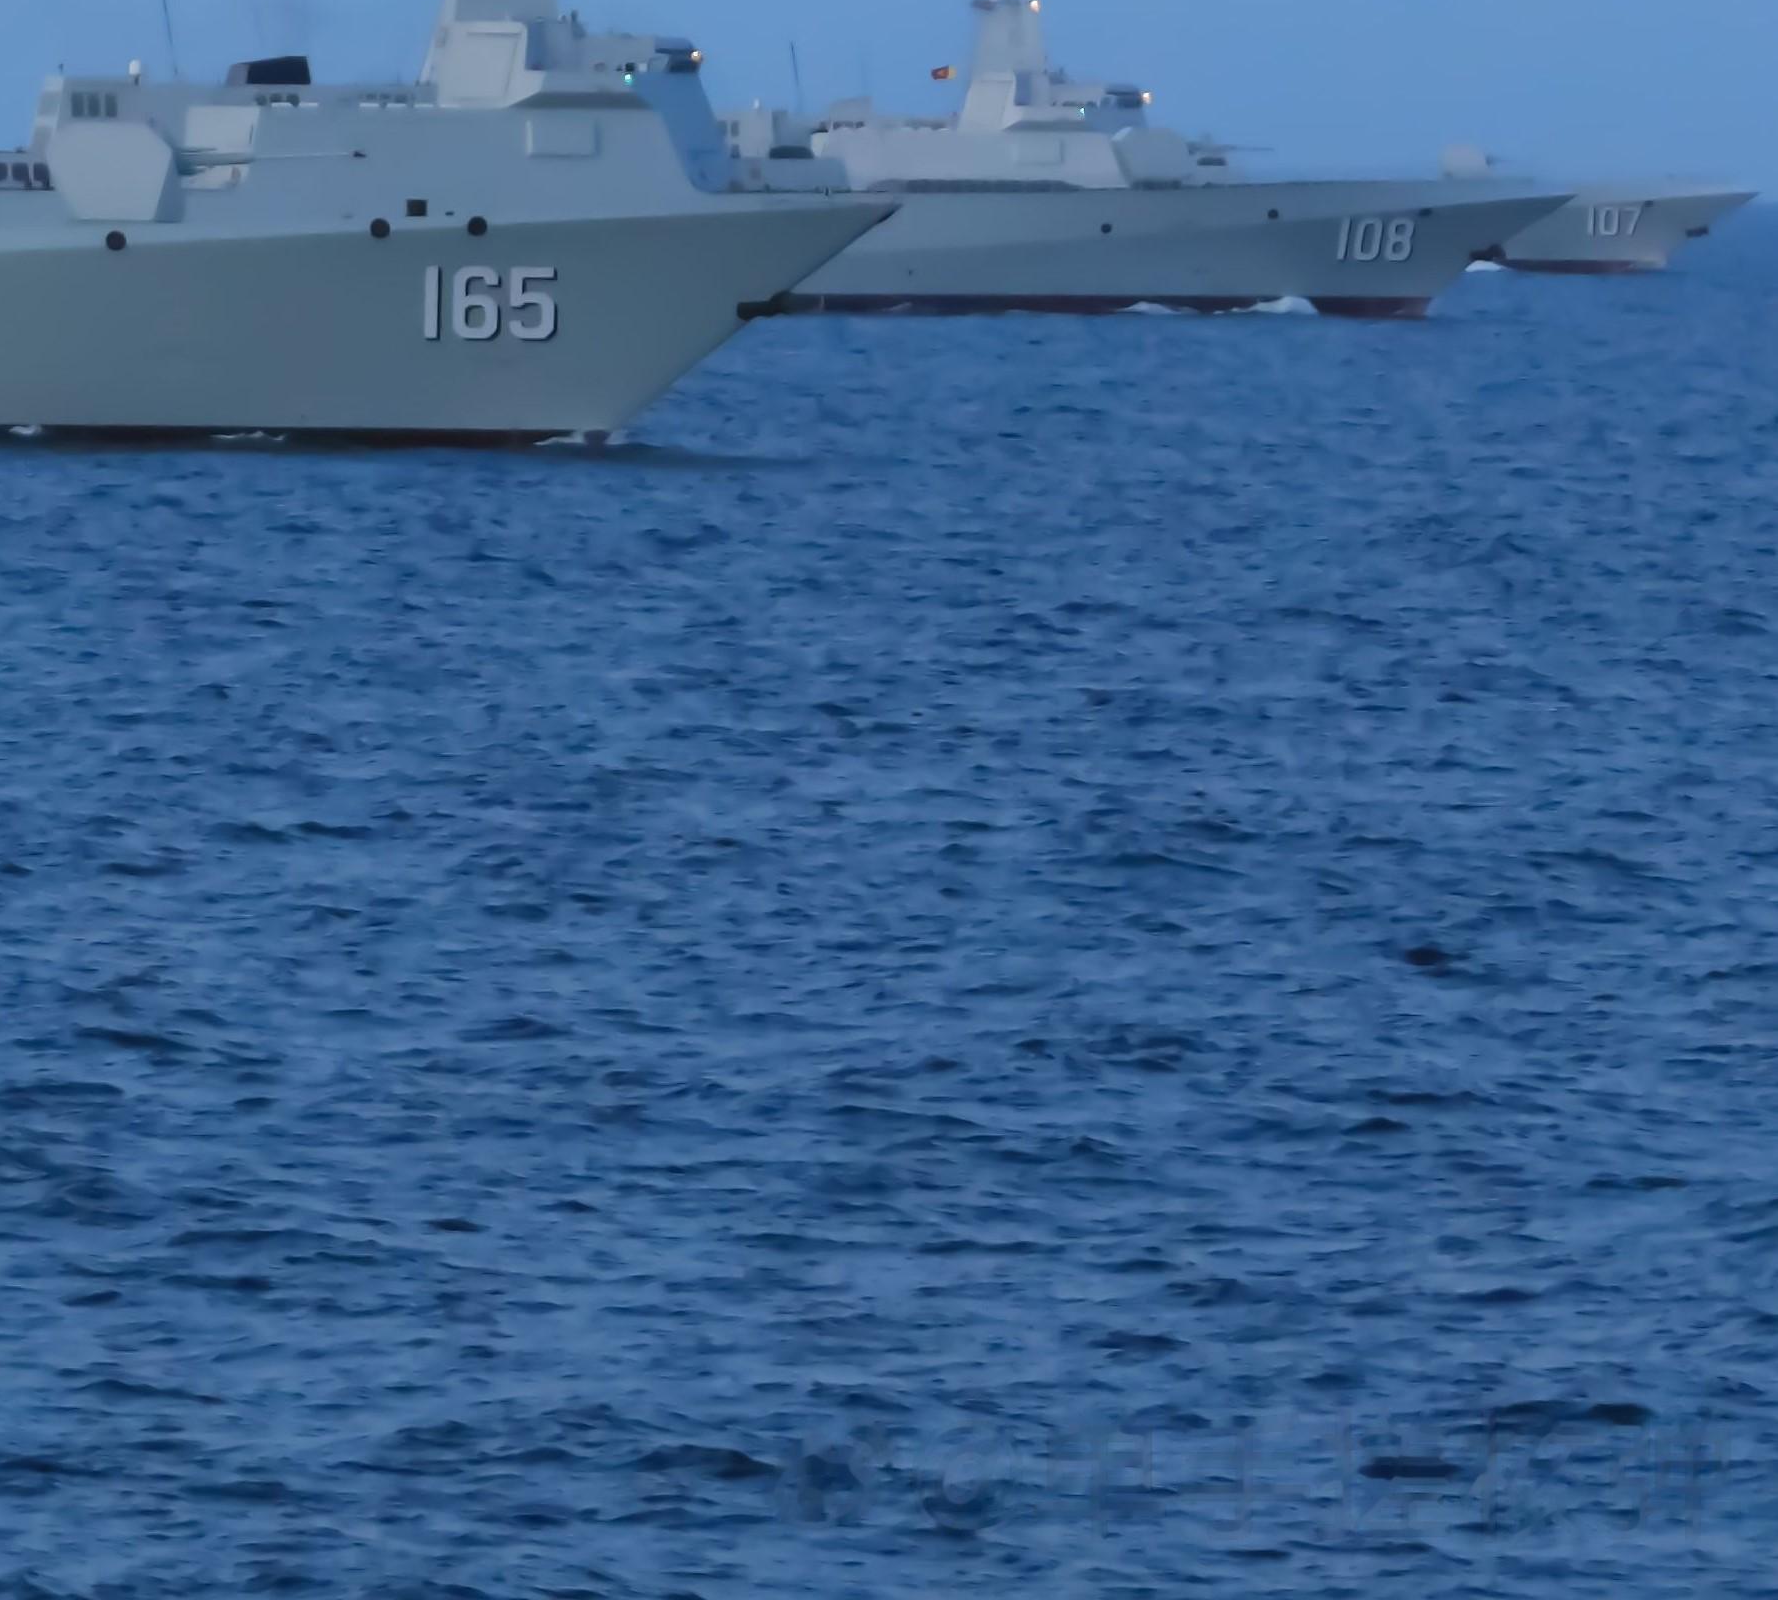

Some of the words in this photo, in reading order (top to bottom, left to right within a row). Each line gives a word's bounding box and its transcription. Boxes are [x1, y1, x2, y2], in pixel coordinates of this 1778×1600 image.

[1336, 216, 1417, 263] 108
[1586, 205, 1643, 238] 107
[423, 264, 558, 342] 165
